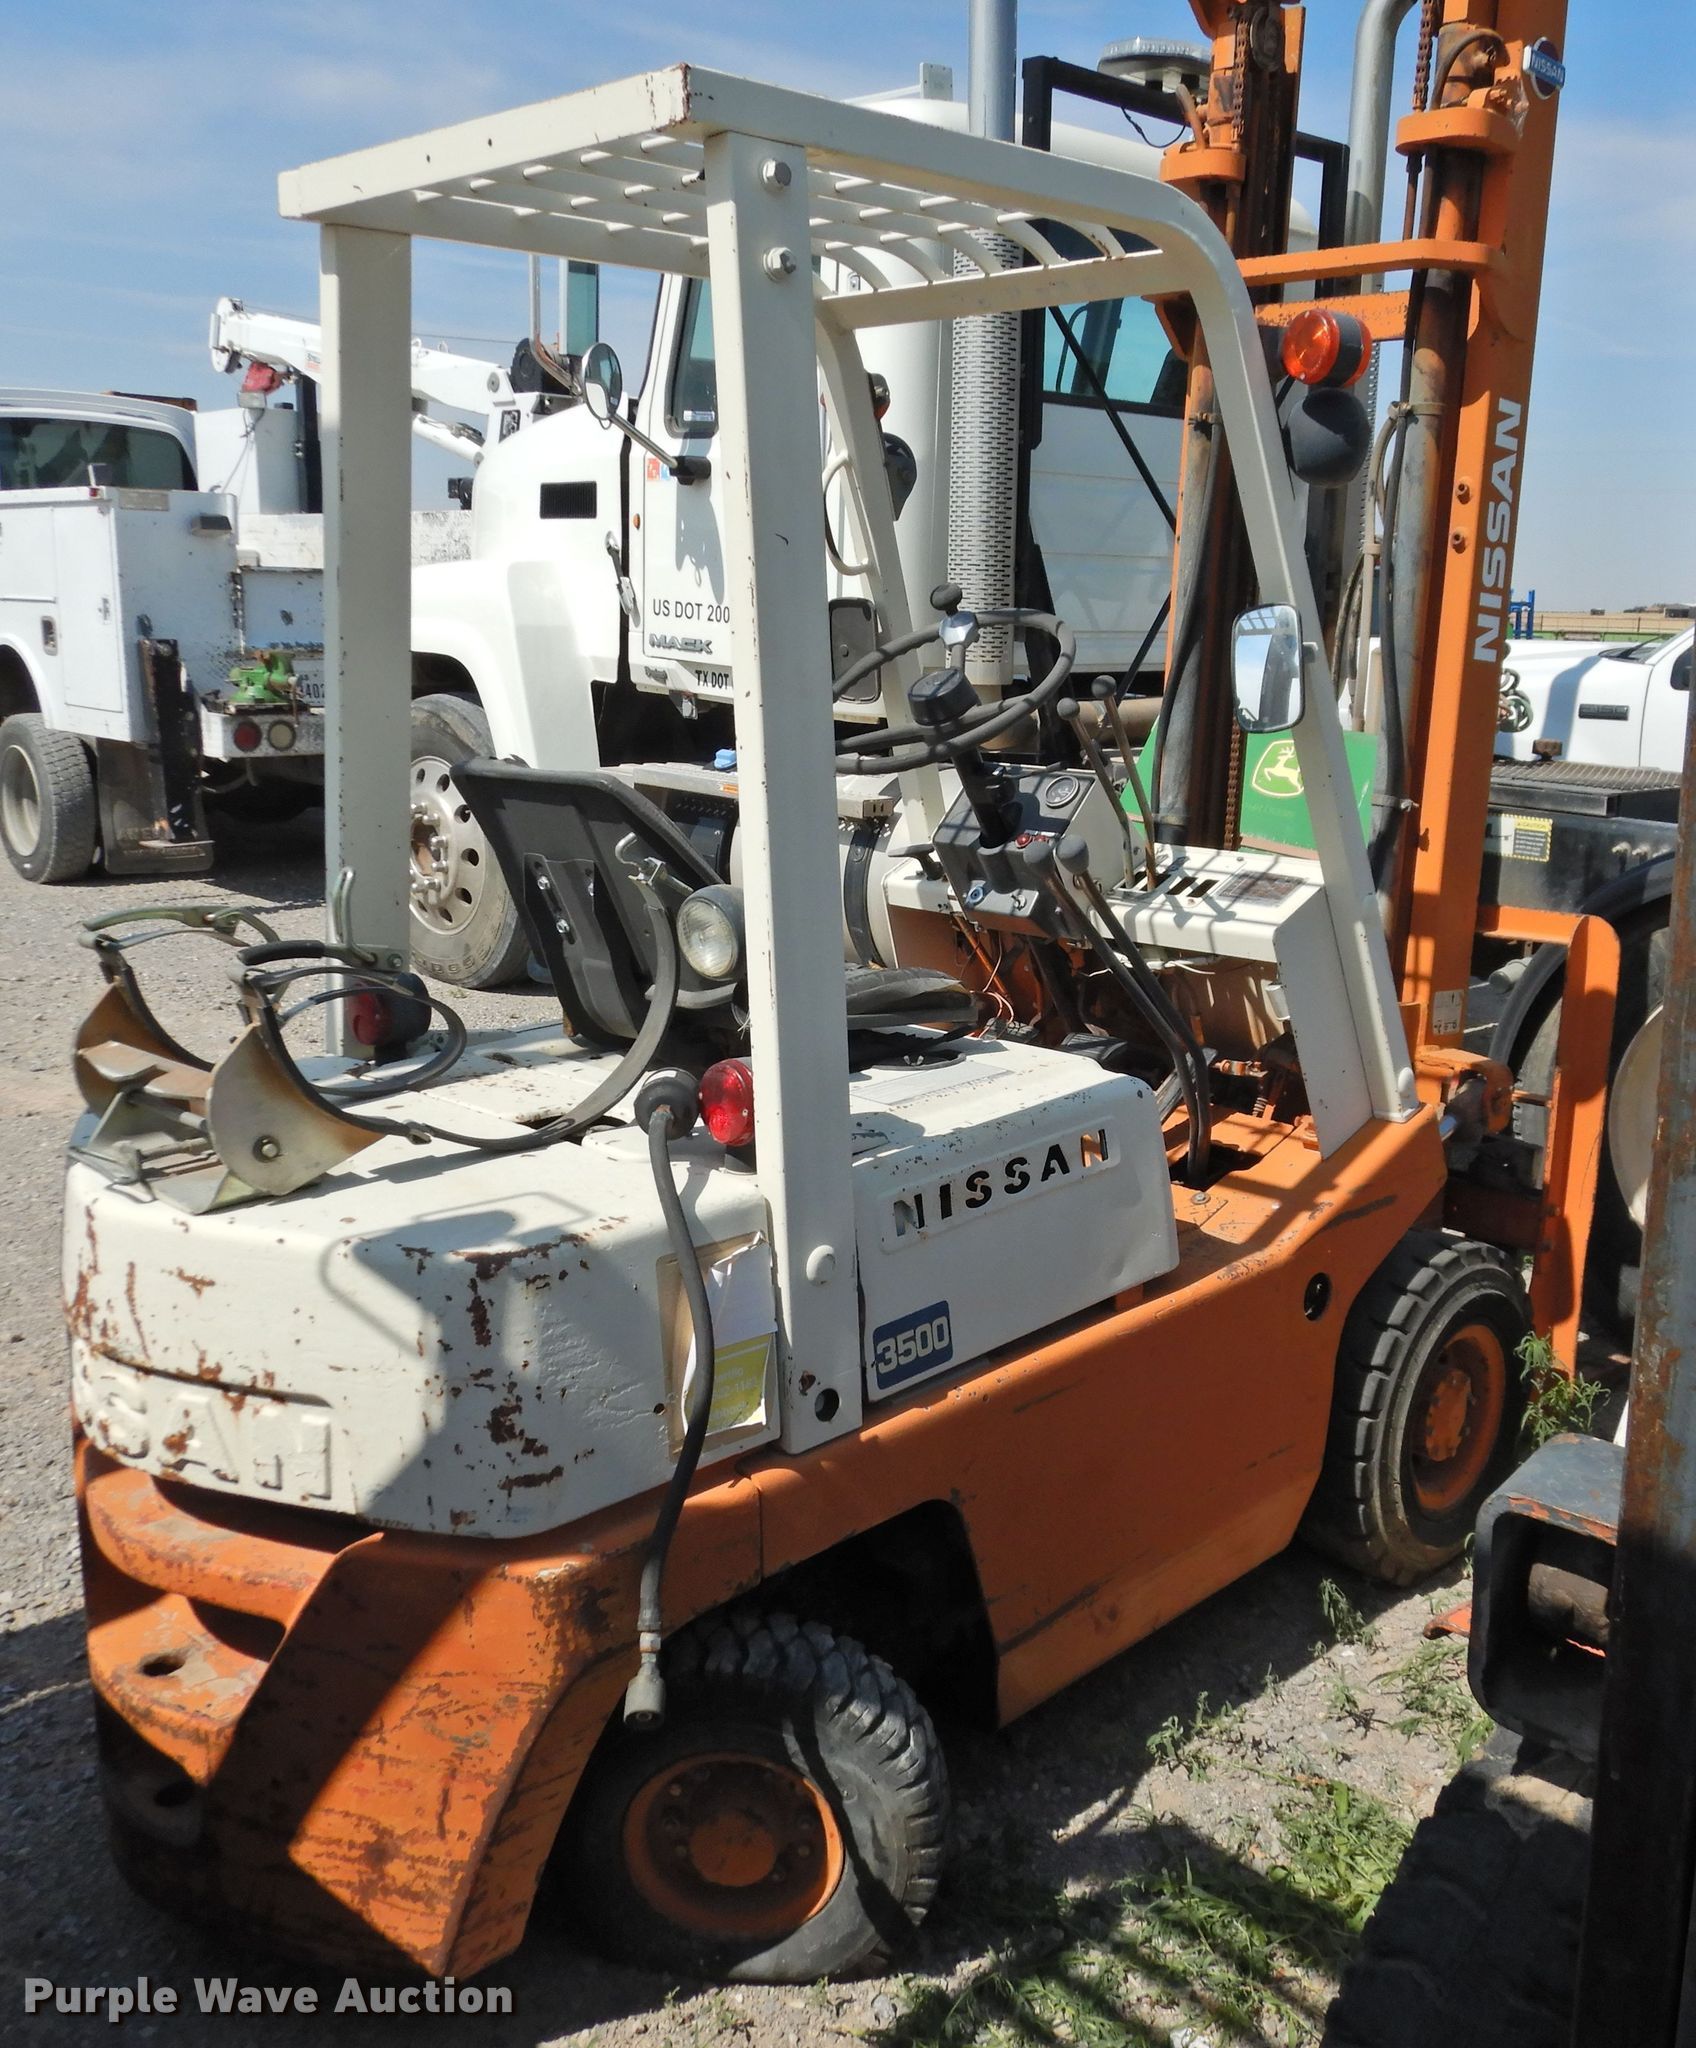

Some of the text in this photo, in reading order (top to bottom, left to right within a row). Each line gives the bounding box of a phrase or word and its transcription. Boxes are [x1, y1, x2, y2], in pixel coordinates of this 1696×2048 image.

[1473, 397, 1522, 663] NISSAN
[653, 599, 730, 624] US DOT 200
[649, 633, 713, 655] MACK
[695, 669, 729, 690] TX DOT
[894, 1129, 1108, 1237] NISSAN
[876, 1315, 951, 1375] 3500
